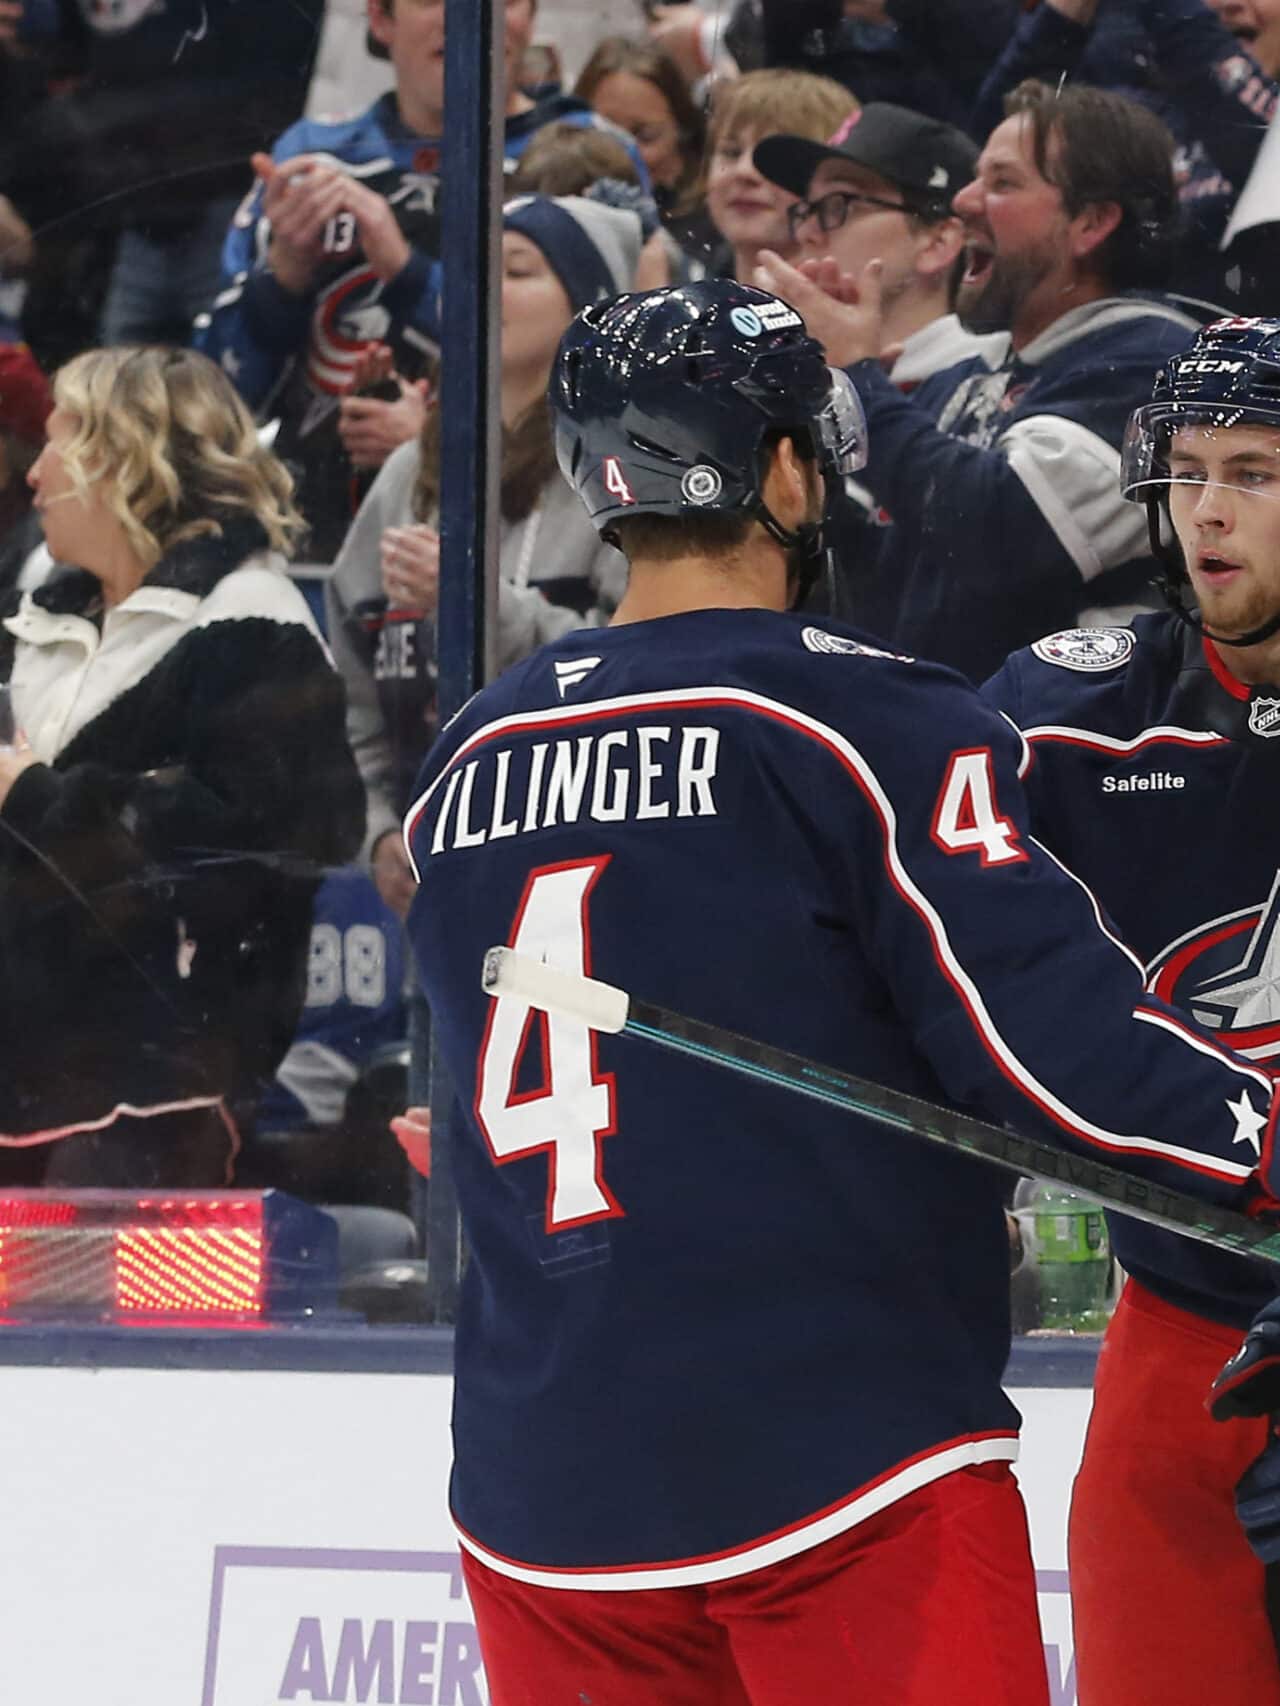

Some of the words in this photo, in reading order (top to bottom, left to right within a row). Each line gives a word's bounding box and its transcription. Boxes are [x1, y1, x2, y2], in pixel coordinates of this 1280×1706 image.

[1177, 360, 1244, 374] CCM
[602, 456, 637, 505] 4
[1102, 772, 1185, 793] Safelite
[929, 746, 1032, 869] 4
[473, 853, 627, 1235] 4
